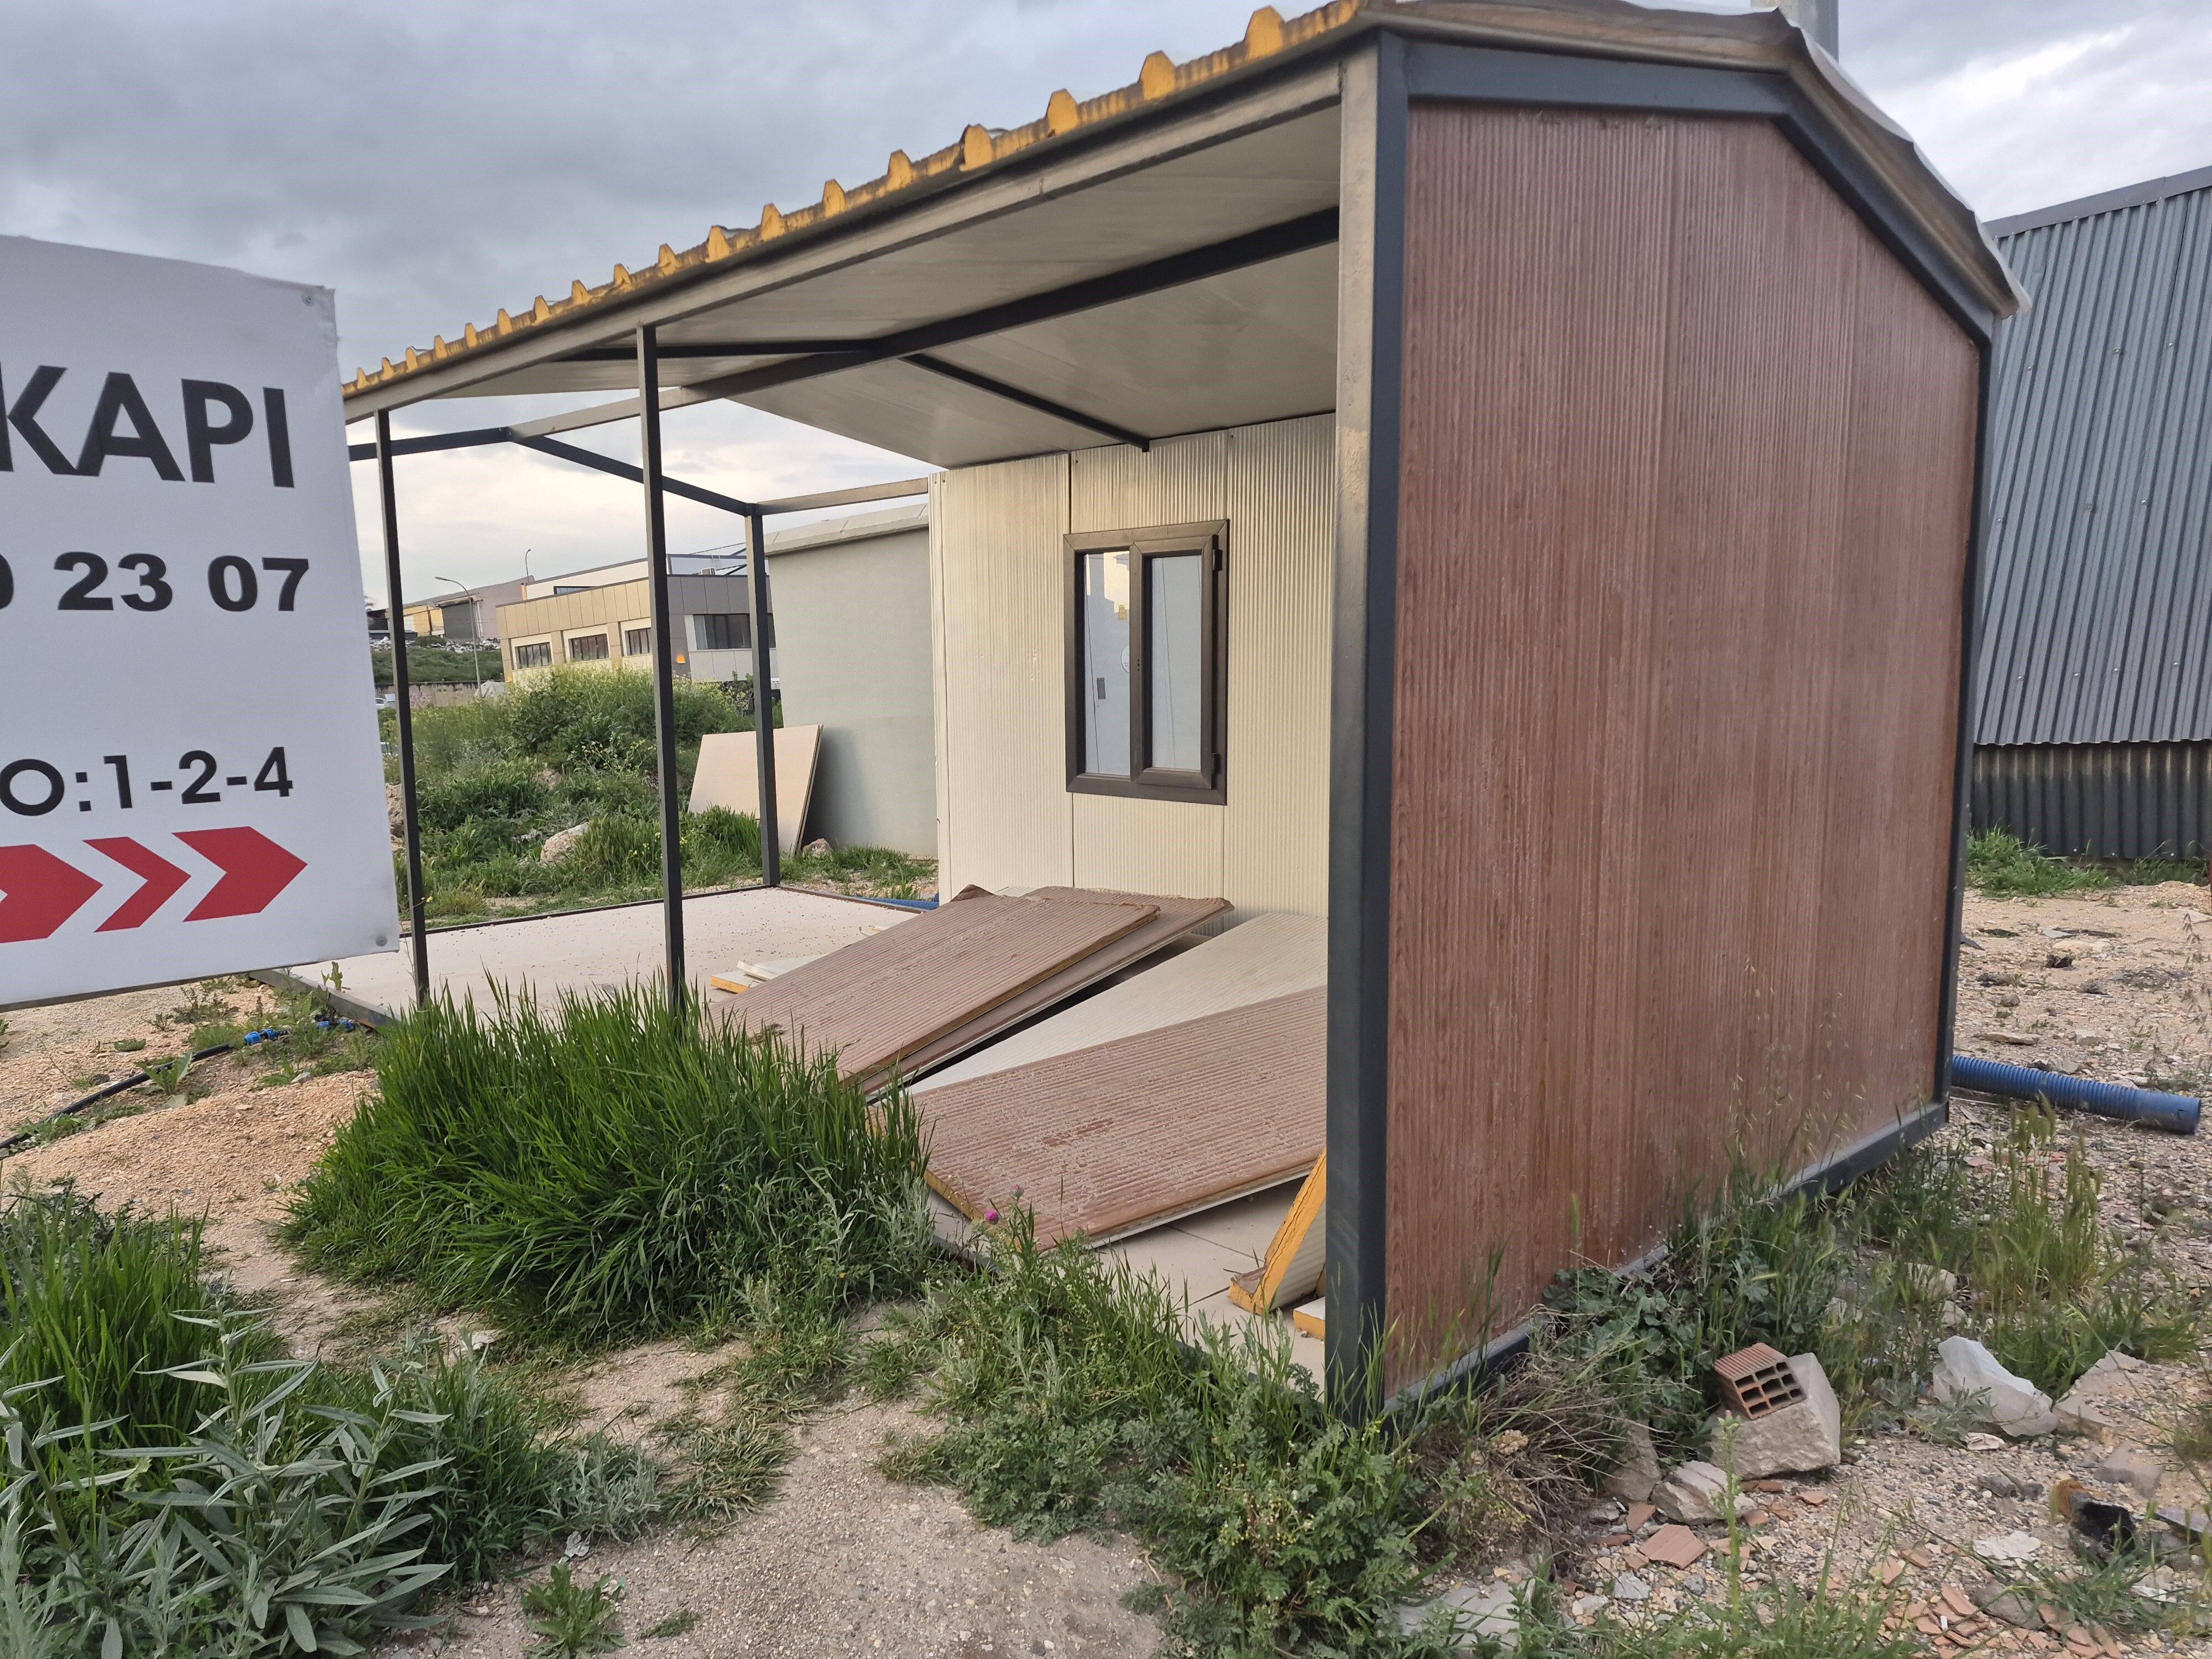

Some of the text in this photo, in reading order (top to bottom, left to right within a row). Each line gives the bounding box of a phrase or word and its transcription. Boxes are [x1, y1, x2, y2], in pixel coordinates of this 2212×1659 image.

[0, 362, 295, 488] KAPI
[54, 551, 173, 612] 23
[207, 555, 309, 612] 07
